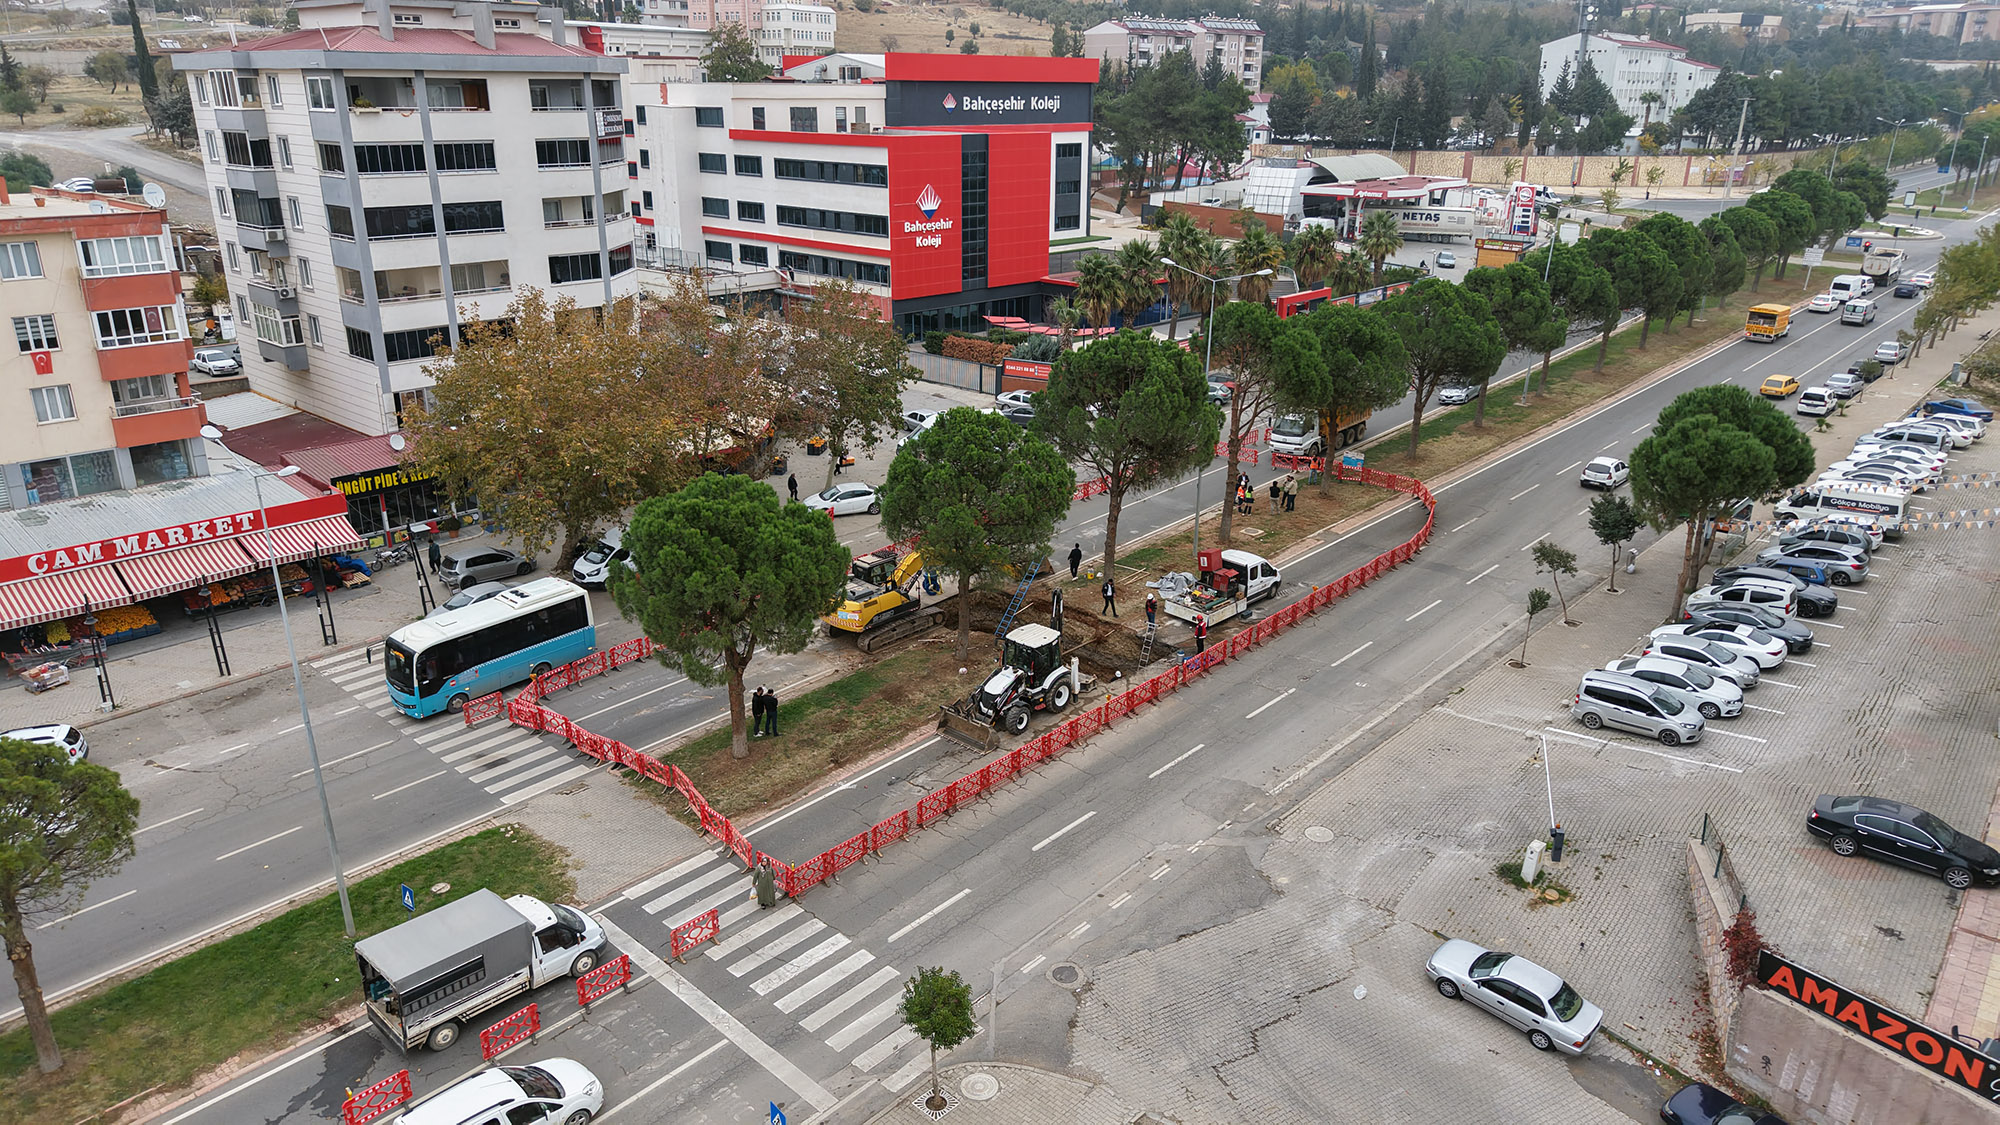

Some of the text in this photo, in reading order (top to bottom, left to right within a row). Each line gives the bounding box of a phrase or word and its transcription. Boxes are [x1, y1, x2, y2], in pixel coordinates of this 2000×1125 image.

[963, 95, 1060, 114] Bahçeşehir Koleji
[904, 217, 953, 234] Bahçeşehir
[1402, 211, 1441, 223] NETAŞ
[916, 234, 942, 248] Koleji
[374, 472, 399, 490] PİDE
[1830, 498, 1856, 508] Gökçe
[1858, 501, 1890, 513] Mobilya
[27, 512, 255, 577] ÇAM MARKET
[1767, 965, 1985, 1089] AMAZON
